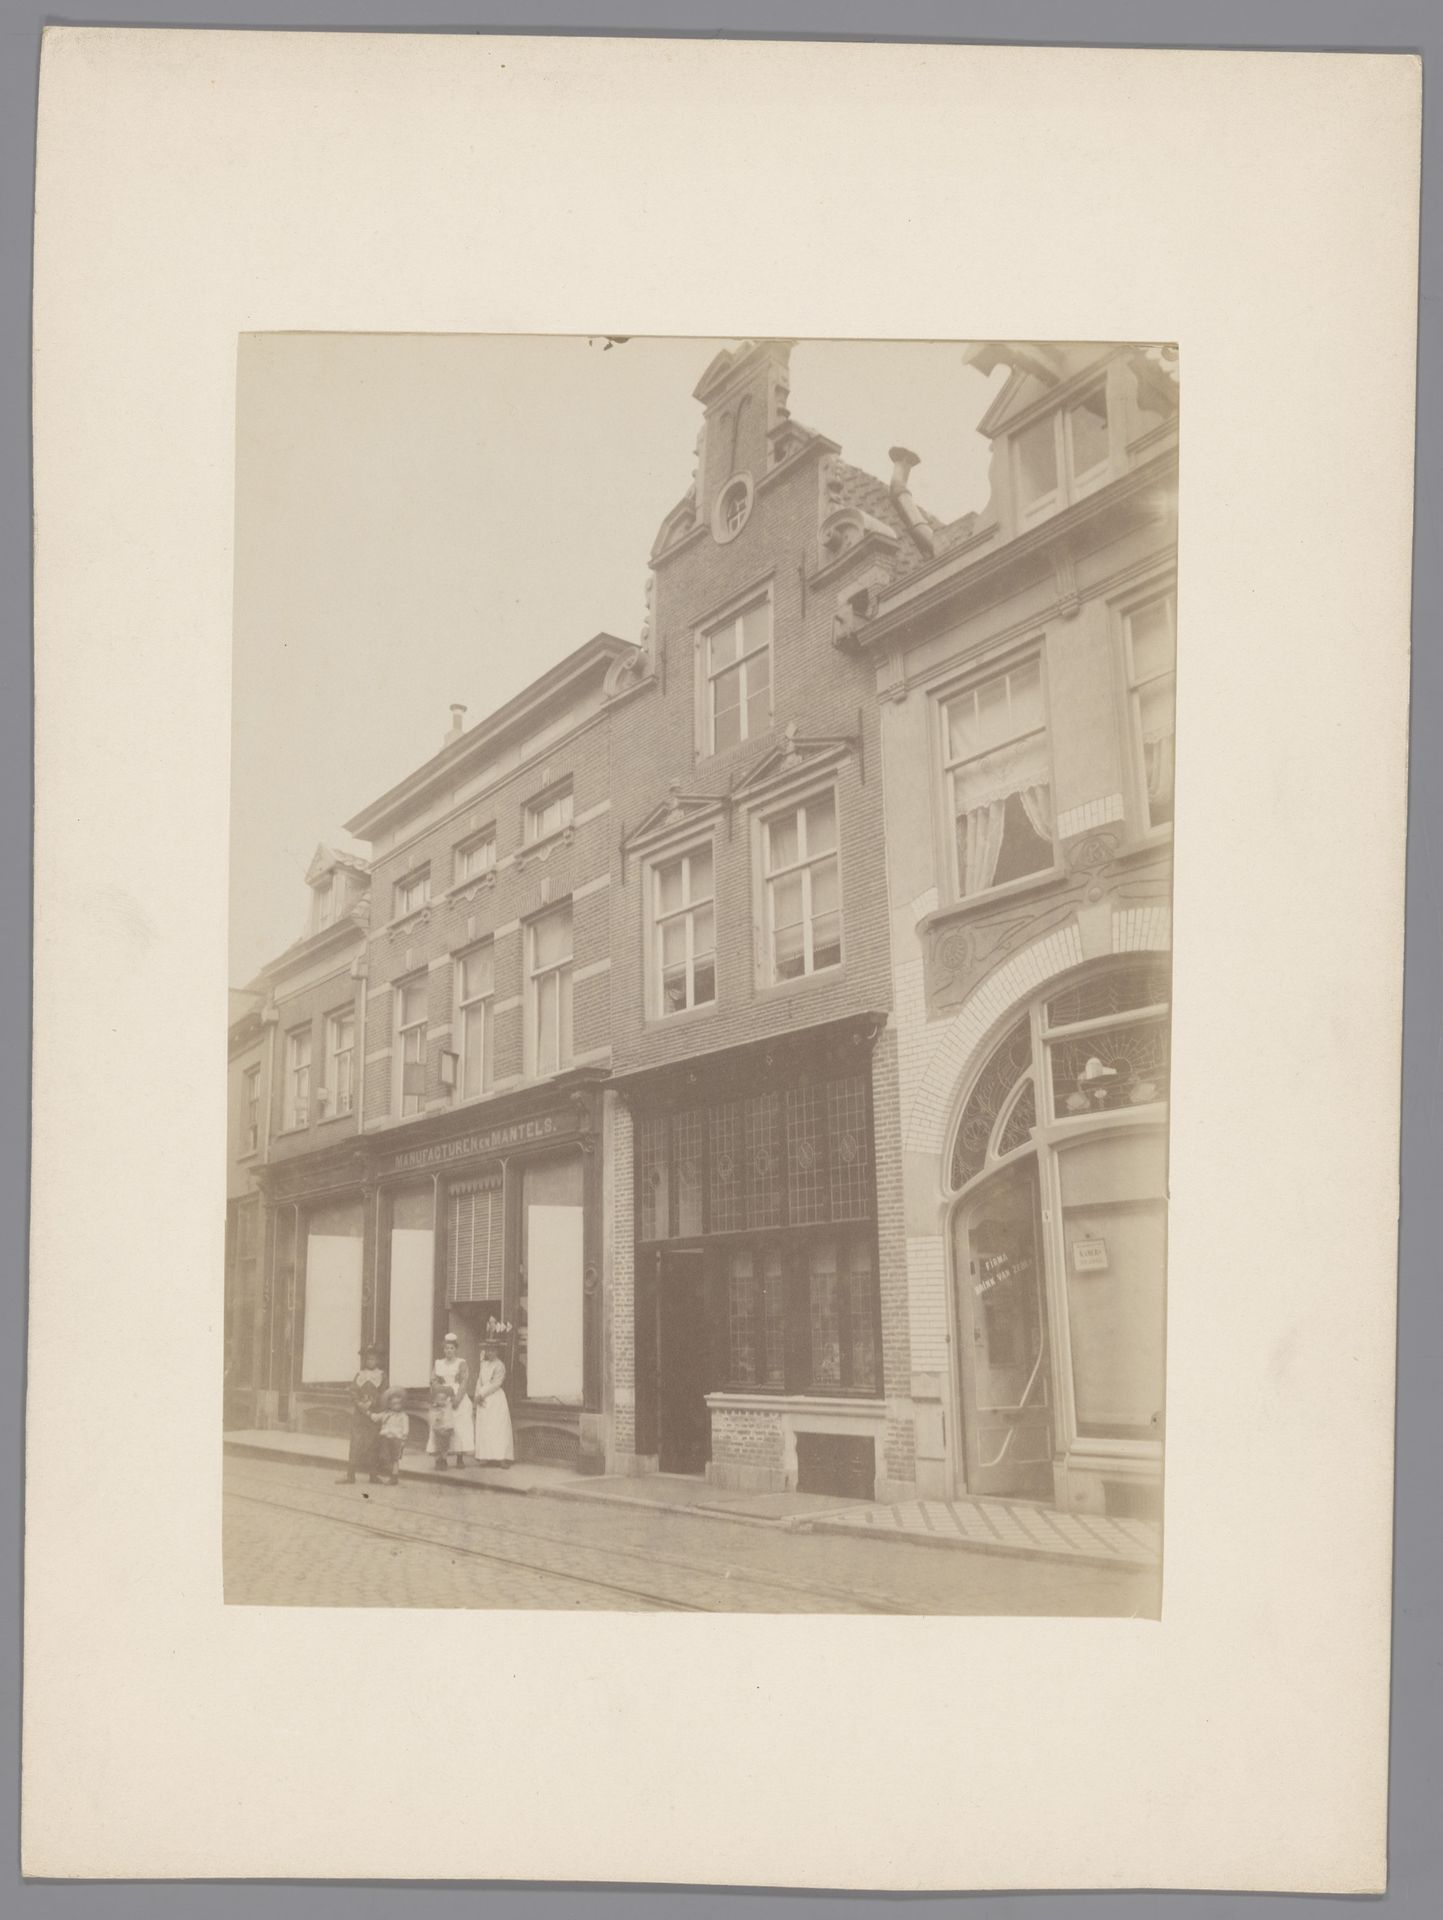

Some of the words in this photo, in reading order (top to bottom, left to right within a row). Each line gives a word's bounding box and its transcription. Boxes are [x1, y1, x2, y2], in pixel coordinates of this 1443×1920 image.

[395, 1137, 479, 1169] MANUFACTUREN
[491, 1118, 557, 1147] MANTELS.
[985, 1252, 1009, 1271] FIRMA
